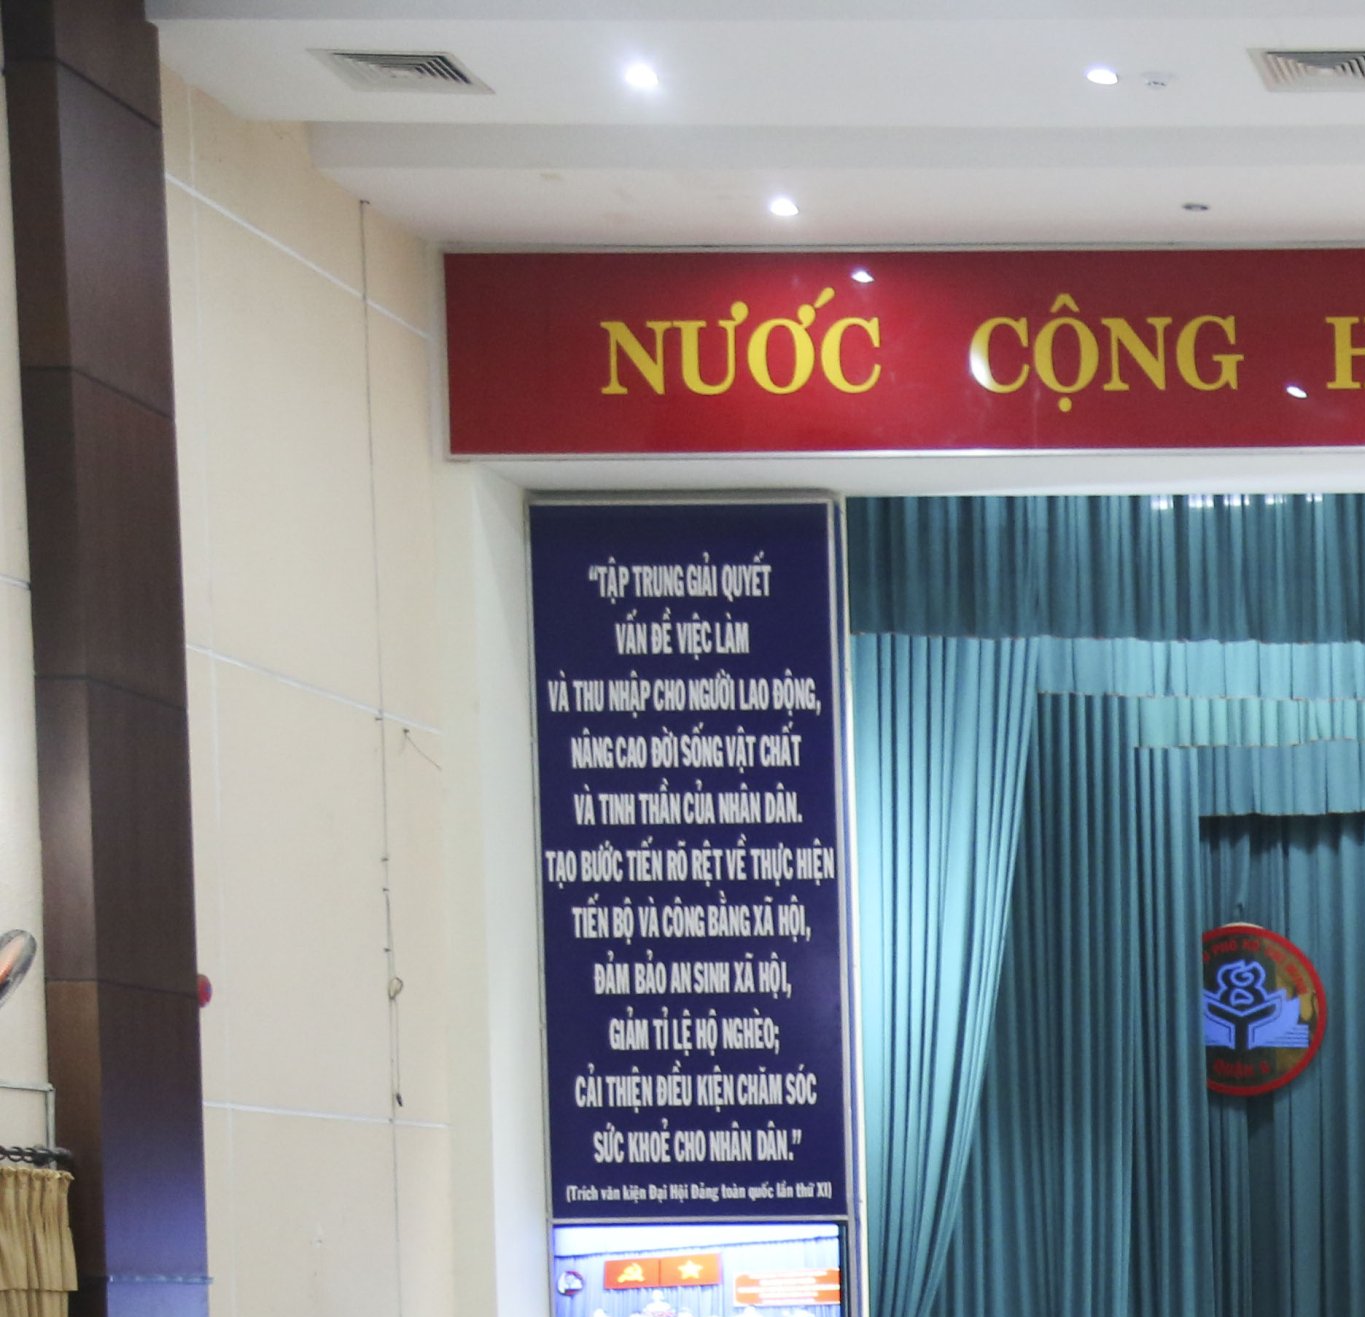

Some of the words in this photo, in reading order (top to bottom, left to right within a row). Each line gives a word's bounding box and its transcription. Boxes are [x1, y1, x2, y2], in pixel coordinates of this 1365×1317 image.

[600, 287, 883, 395] NƯỚC
[969, 293, 1245, 412] CỘNG
[632, 565, 684, 597] TRUNG
[686, 552, 717, 596] GIẢI
[721, 552, 771, 602] QUYẾT
[616, 609, 647, 654] VẤN
[651, 608, 672, 654] ĐỀ
[676, 613, 712, 660] VIỆC
[715, 613, 749, 653] LÀM
[548, 671, 569, 711] VÀ
[573, 680, 604, 711] THU
[609, 670, 651, 718] NHẬP
[653, 679, 686, 711] CHO
[689, 669, 735, 710] NGƯỜI
[739, 678, 769, 710] LAO
[772, 669, 821, 716] ĐỘNG,
[574, 784, 595, 825] VÀ
[599, 794, 635, 824] TINH
[638, 778, 682, 824] THẦN
[683, 779, 715, 824] CỦA
[718, 783, 761, 823] NHÂN
[765, 783, 802, 823] DÂN.
[594, 951, 630, 994] ĐẢM
[635, 950, 666, 994] BẢO
[671, 962, 692, 993] AN
[694, 962, 729, 993] SINH
[734, 953, 755, 992] XÃ
[759, 952, 791, 999] HỘI,
[609, 1006, 649, 1050] GIẢM
[653, 1007, 668, 1050] TỈ
[673, 1009, 692, 1056] LỆ
[696, 1009, 717, 1056] HỘ
[722, 1008, 779, 1054] NGHÈO;
[593, 1123, 624, 1163] SỨC
[628, 1118, 671, 1162] KHOẺ
[674, 1130, 706, 1162] CHO
[710, 1121, 752, 1161] NHÂN
